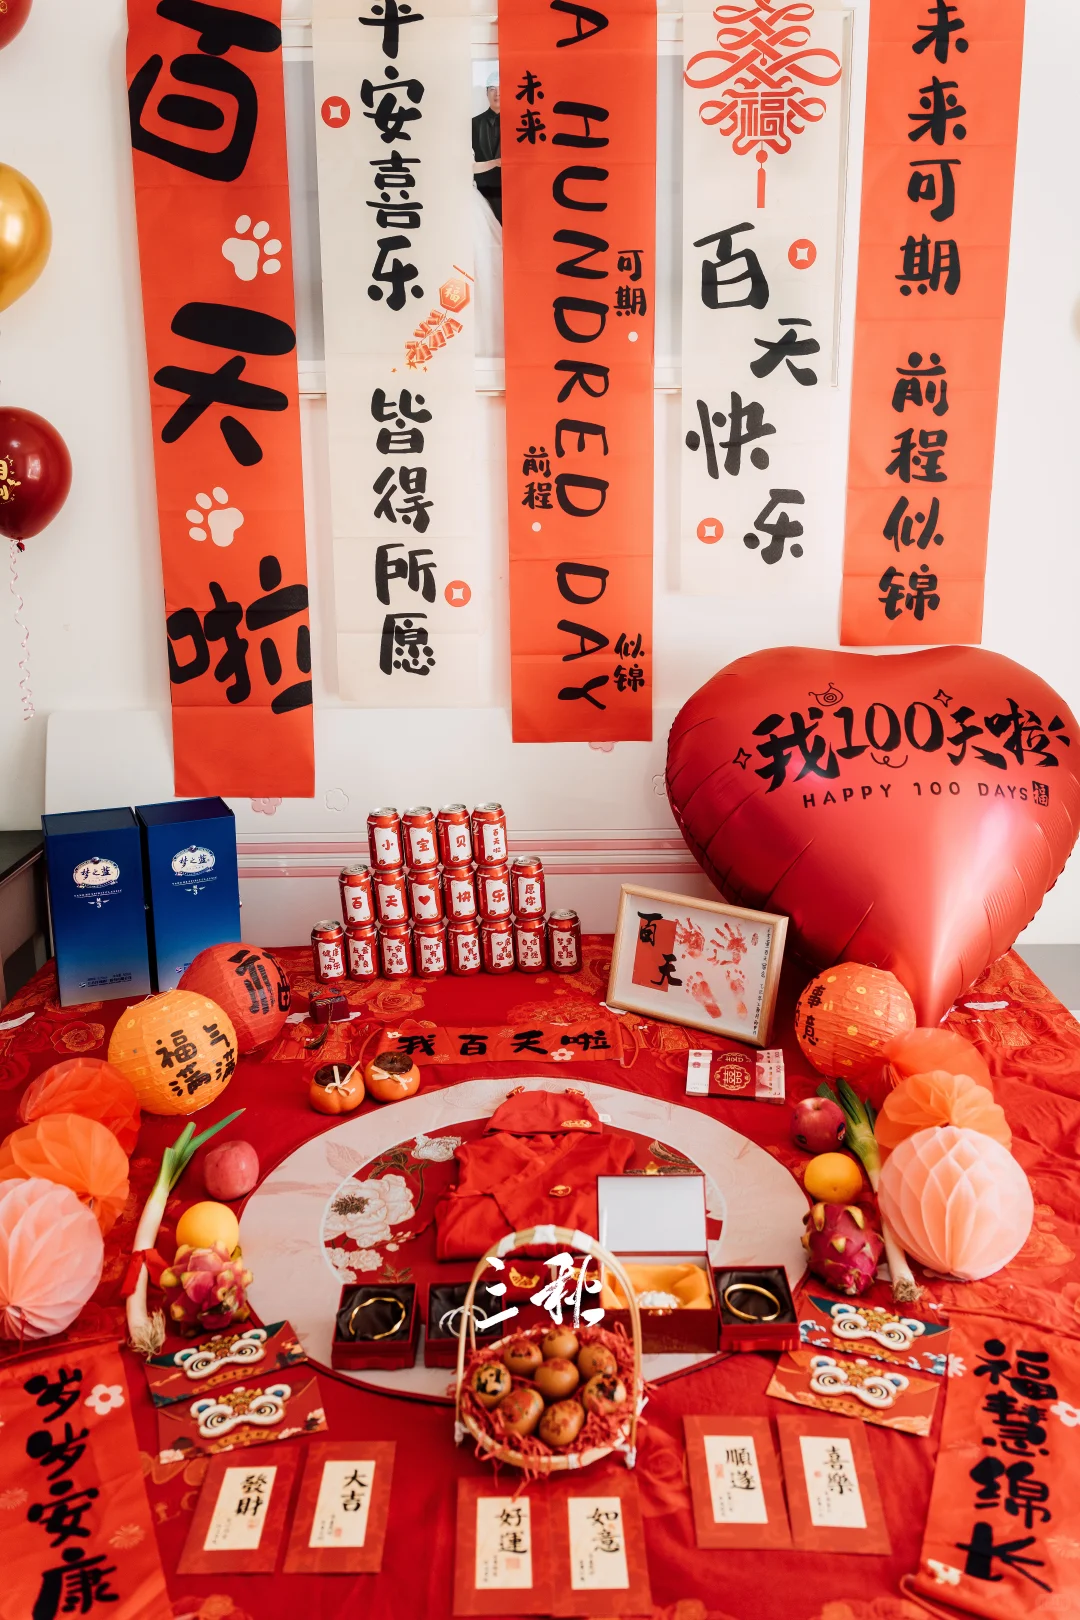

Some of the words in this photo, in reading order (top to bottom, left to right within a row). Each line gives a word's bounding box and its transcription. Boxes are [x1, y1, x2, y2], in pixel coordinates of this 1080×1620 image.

[556, 0, 608, 48] A
[516, 70, 546, 144] 未来
[359, 0, 424, 311] 平安喜乐
[895, 0, 968, 297] 未来可期
[613, 249, 647, 317] 可期
[552, 100, 609, 518] HUNDRED
[129, 0, 311, 715] 百天啦
[686, 222, 820, 565] 百天快乐
[521, 446, 554, 510] 前程
[879, 352, 948, 621] 前程似锦
[371, 388, 437, 676] 皆得所愿
[556, 562, 609, 711] DAY
[613, 633, 645, 693] 似锦
[752, 697, 1070, 794] 我100天啦
[802, 783, 891, 809] HAPPY
[913, 781, 961, 796] 100
[978, 783, 1028, 801] DAYS
[382, 840, 393, 850] 小
[417, 838, 429, 852] 宝
[456, 835, 466, 847] 贝
[81, 866, 111, 880] 梦之蓝
[456, 891, 471, 902] 快
[492, 889, 505, 903] 乐
[524, 884, 536, 906] 愿你
[352, 896, 362, 909] 百
[385, 895, 397, 907] 天
[637, 911, 683, 987] 百天
[397, 1029, 611, 1057] 我百天啦
[725, 1447, 755, 1490] 順遂
[823, 1445, 854, 1494] 喜樂
[956, 1339, 1058, 1592] 福慧绵长
[24, 1368, 119, 1620] 岁岁安康
[236, 1473, 267, 1516] 發財
[341, 1469, 368, 1512] 大吉
[494, 1508, 528, 1554] 好運
[586, 1507, 620, 1553] 如意
